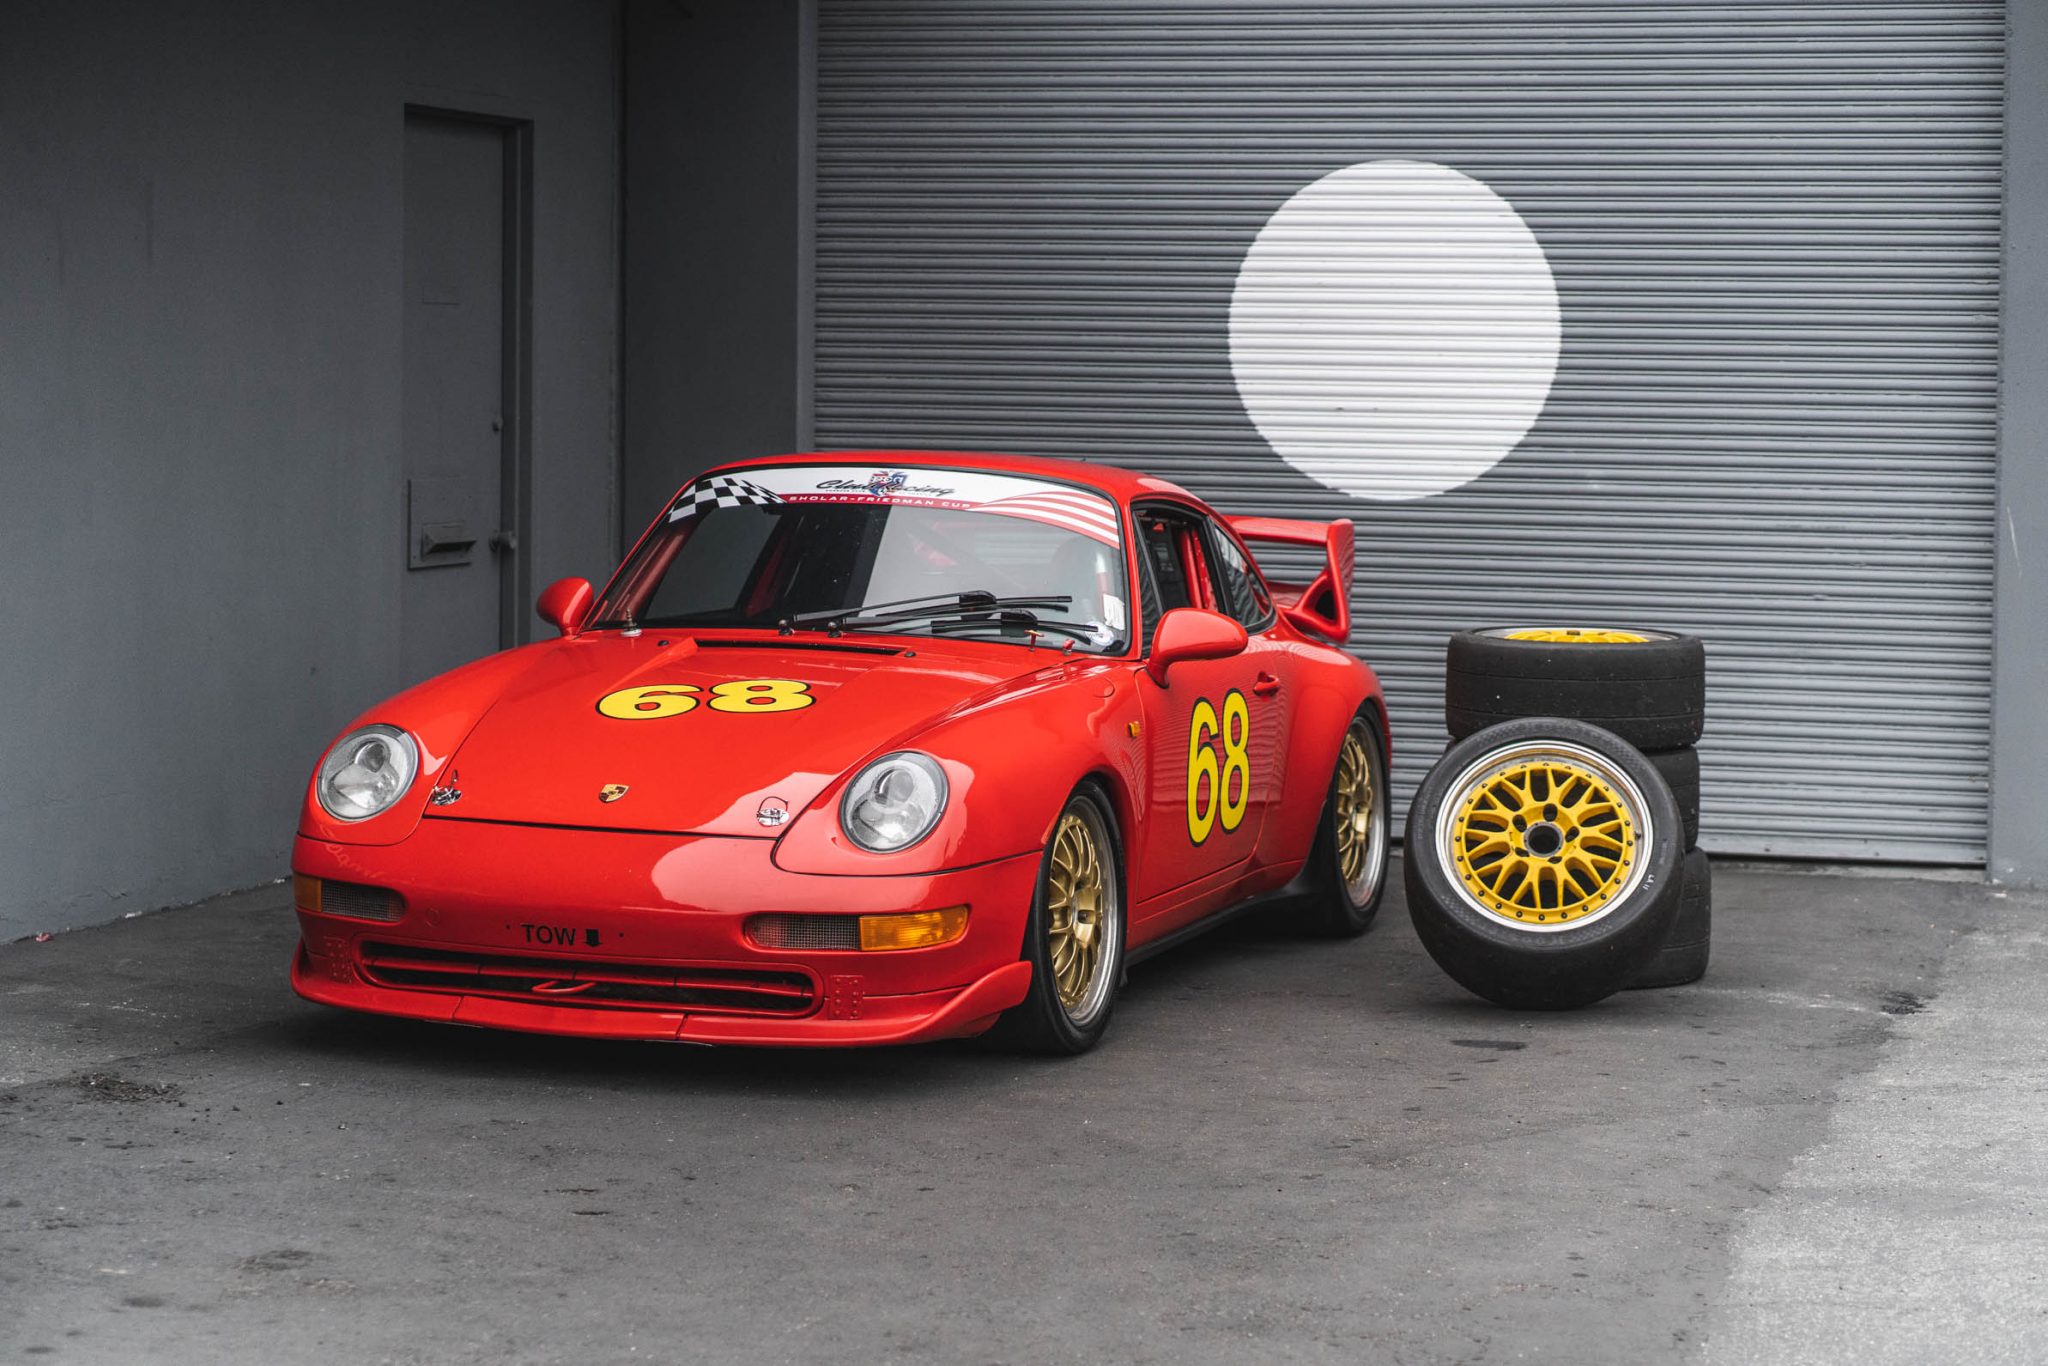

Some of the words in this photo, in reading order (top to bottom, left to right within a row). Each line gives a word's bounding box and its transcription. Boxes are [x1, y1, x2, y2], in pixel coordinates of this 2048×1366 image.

[789, 495, 934, 505] SHOLAR-FRIEDMAN
[595, 678, 817, 720] 68
[1186, 687, 1250, 848] 68
[520, 923, 577, 946] TOW
